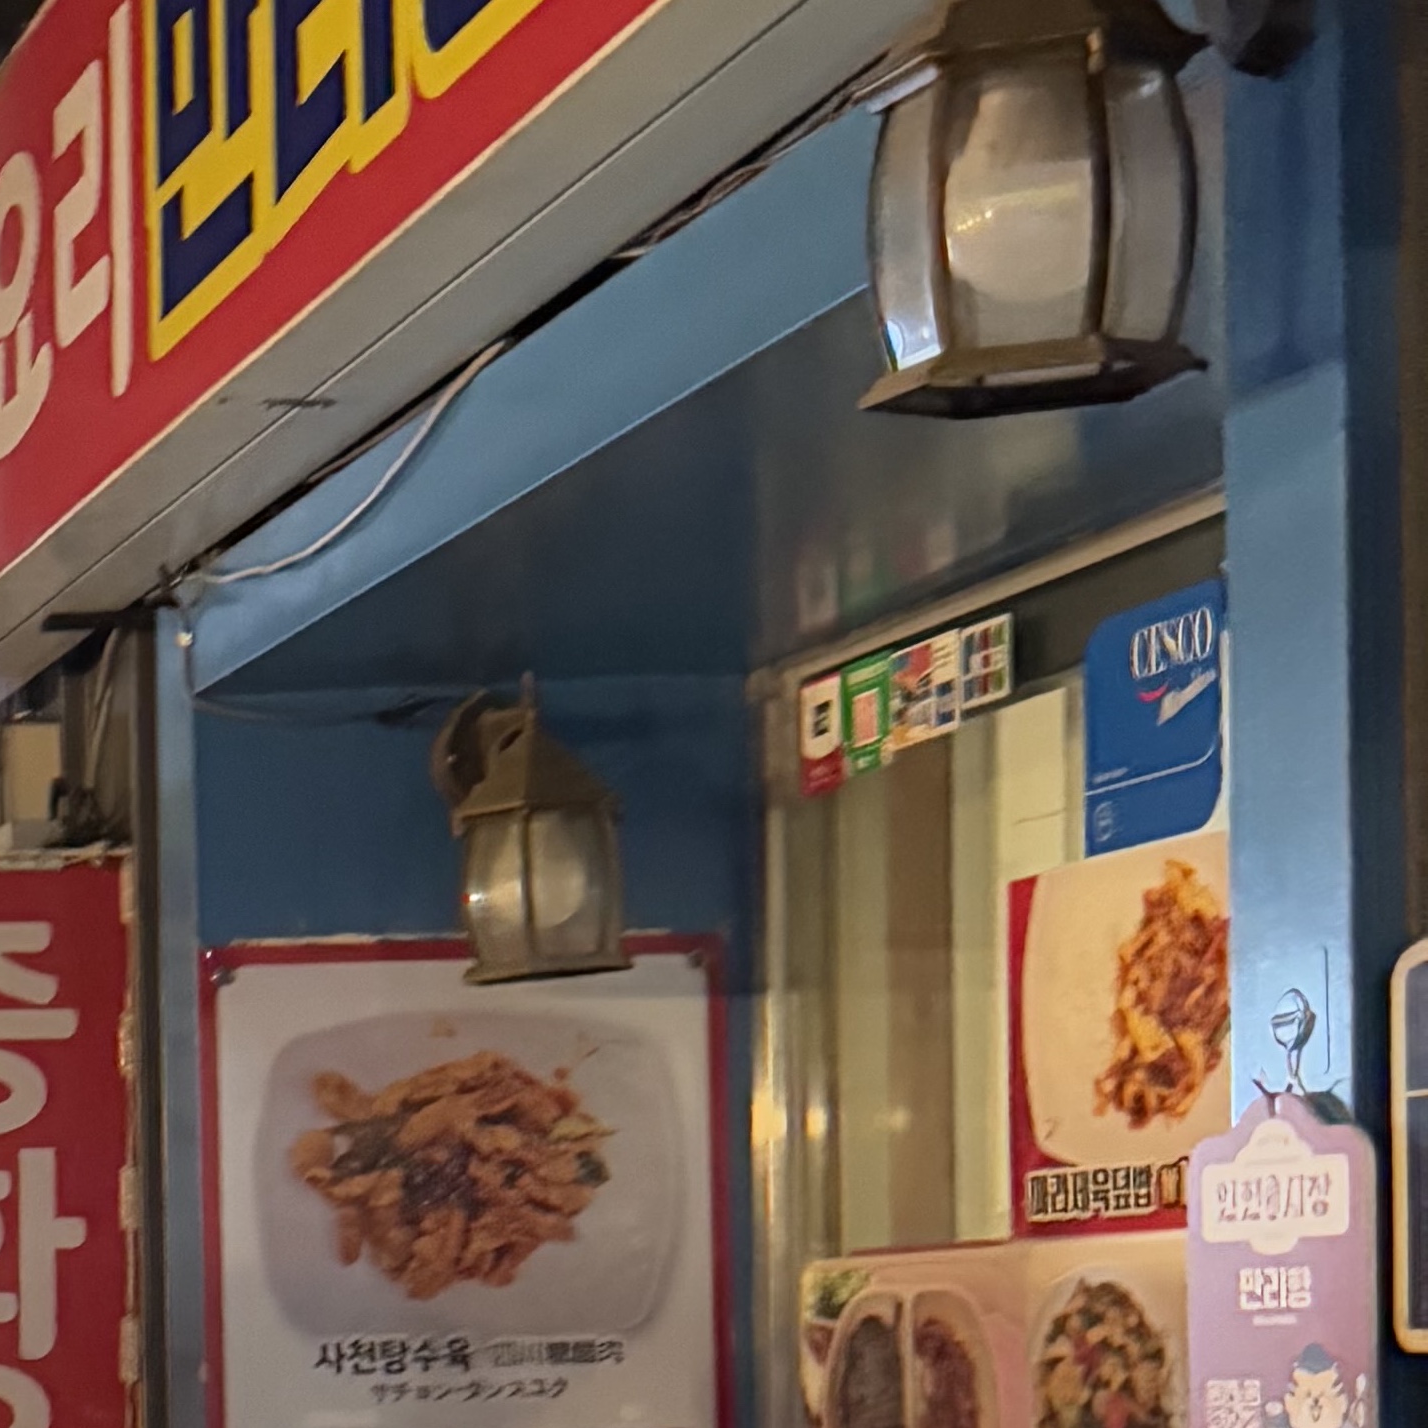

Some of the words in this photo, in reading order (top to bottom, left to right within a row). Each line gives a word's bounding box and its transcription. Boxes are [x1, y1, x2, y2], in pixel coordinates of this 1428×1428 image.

[149, 0, 495, 345] 만리
[1130, 606, 1213, 680] CESCO
[1239, 1264, 1312, 1311] 만리향
[314, 1335, 471, 1376] 사천탕수육
